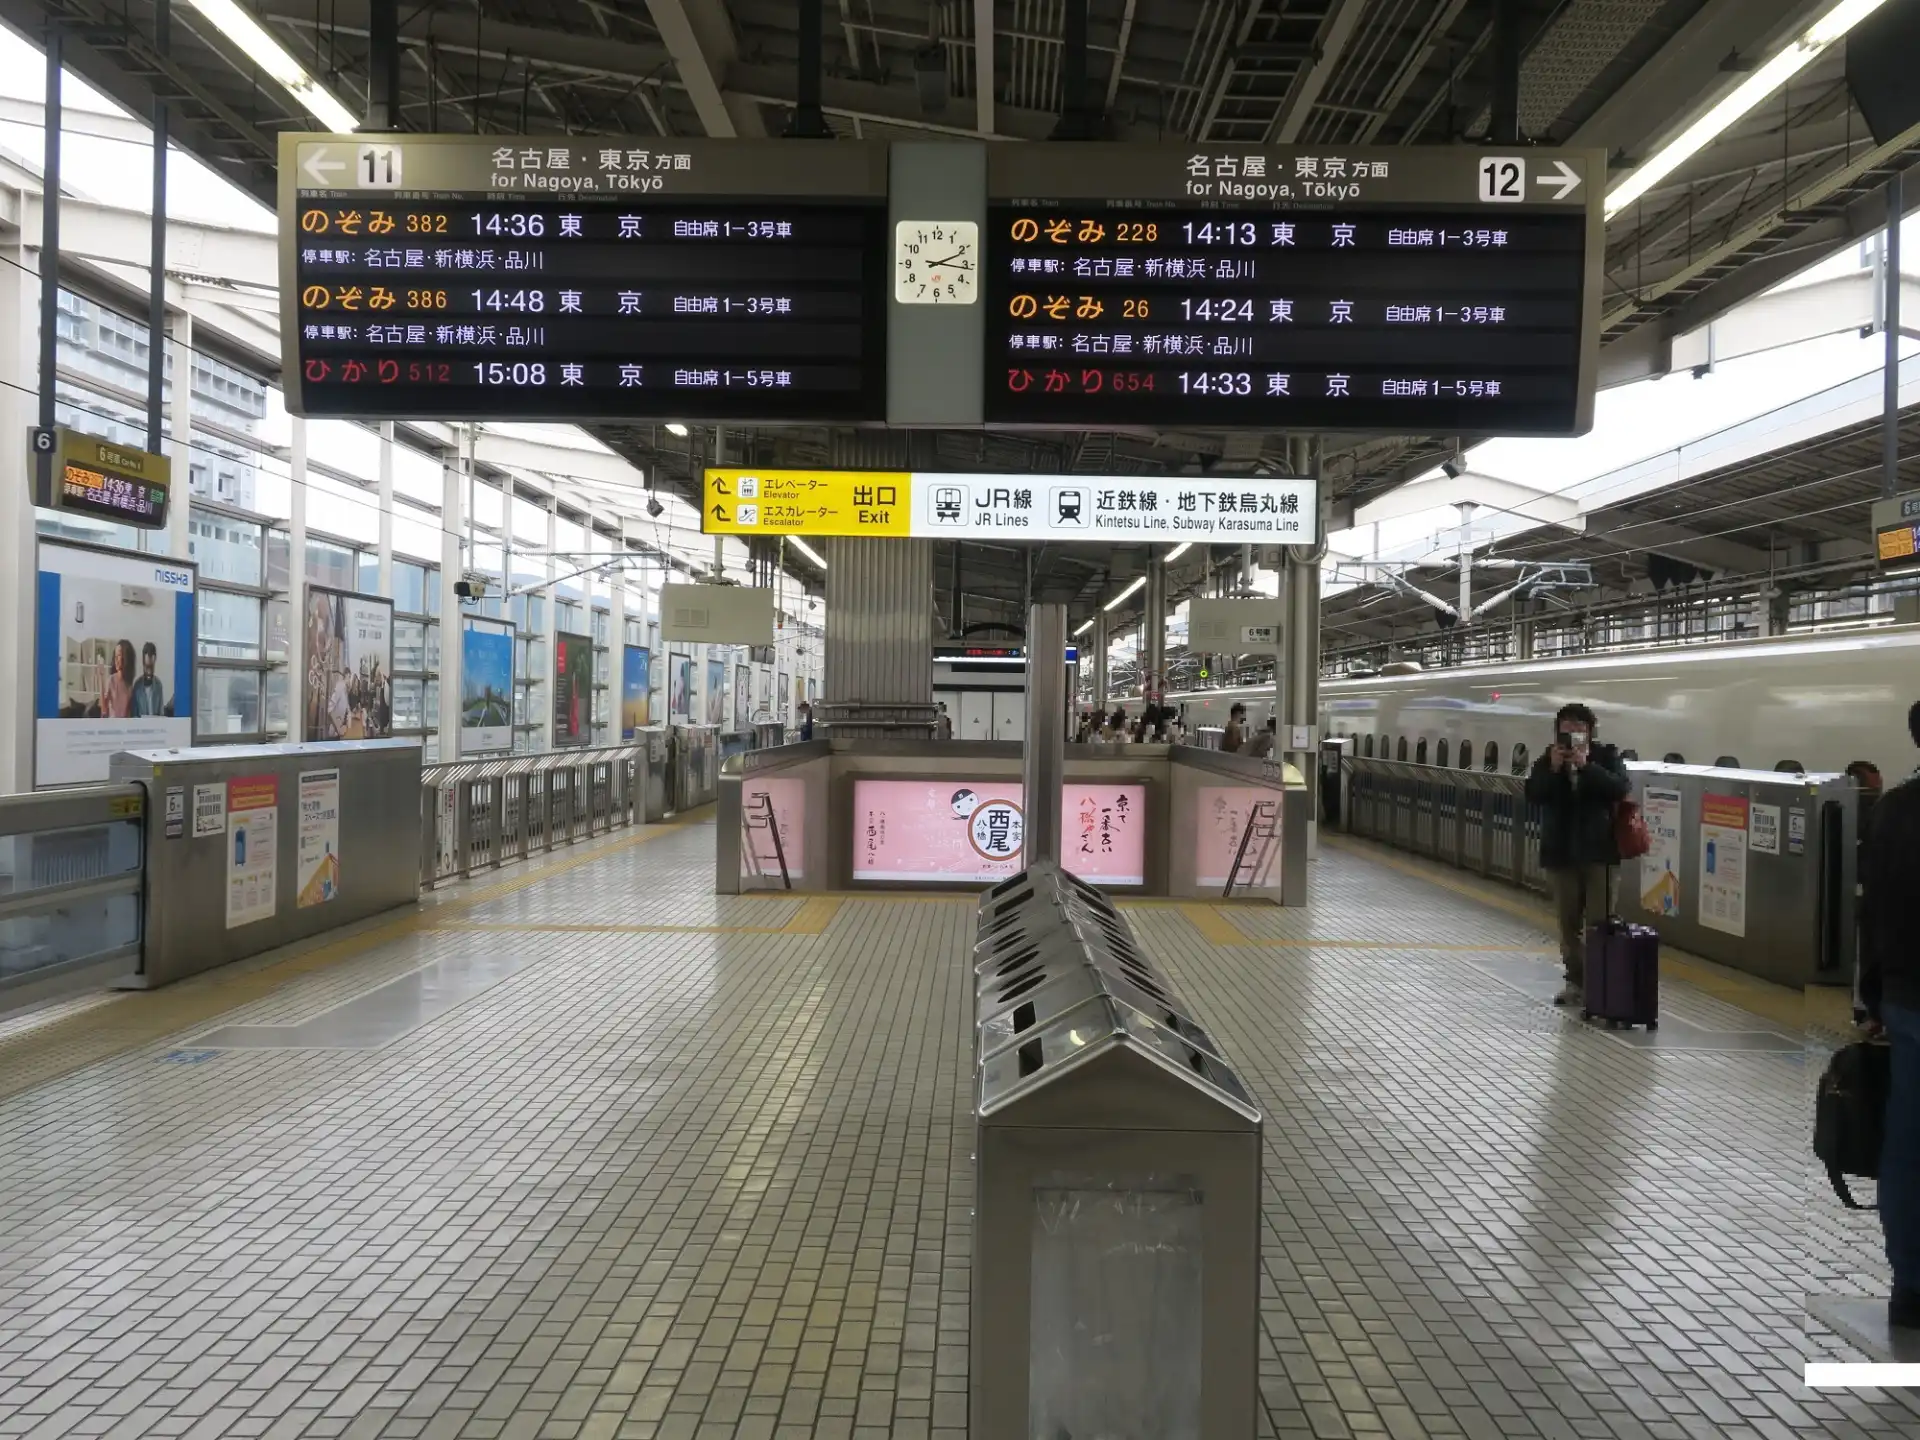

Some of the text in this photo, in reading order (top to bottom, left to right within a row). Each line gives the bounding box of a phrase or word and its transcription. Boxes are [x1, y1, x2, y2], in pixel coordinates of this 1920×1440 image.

[363, 150, 394, 183] 11
[490, 173, 663, 193] for Nagoya, Tōkyō
[1483, 163, 1520, 197] 12
[1186, 180, 1360, 200] for Nagoya, Tōkyō
[302, 209, 396, 234] のぞみ
[406, 214, 448, 233] 382
[471, 213, 544, 236] 14:36
[918, 234, 928, 244] 11
[932, 230, 943, 240] 12
[1010, 219, 1105, 243] のぞみ
[1116, 224, 1158, 241] 228
[1183, 222, 1256, 245] 14:13
[949, 235, 954, 244] 1
[909, 244, 919, 254] 10
[959, 245, 965, 255] 2
[905, 259, 912, 269] 9
[962, 260, 969, 269] 3
[909, 273, 916, 283] 8
[958, 274, 964, 283] 4
[920, 284, 926, 294] 7
[933, 288, 940, 298] 6
[948, 284, 954, 294] 5
[303, 285, 396, 310] のぞみ
[407, 290, 447, 308] 386
[471, 289, 544, 312] 14:48
[1009, 295, 1104, 319] のぞみ
[1123, 300, 1149, 318] 26
[1181, 299, 1254, 321] 14:24
[305, 360, 399, 382] ひかり
[409, 364, 449, 381] 512
[473, 362, 546, 385] 15:08
[1008, 368, 1102, 393] ひかり
[1113, 373, 1155, 390] 654
[1178, 372, 1251, 395] 14:33
[37, 433, 50, 449] 6
[764, 479, 828, 490] エレベーター
[764, 490, 800, 499] Elevator
[853, 485, 896, 507] 出口
[975, 488, 1032, 511] JR線
[764, 506, 838, 518] エスカレーター
[859, 510, 890, 524] Exit
[763, 517, 804, 527] Escalator
[975, 513, 1029, 527] JR Lines
[1096, 516, 1140, 529] Kintetsu
[1172, 516, 1215, 532] Subway
[1218, 518, 1272, 531] Karasuma
[1276, 518, 1299, 532] Line
[986, 810, 1011, 852] 西尾
